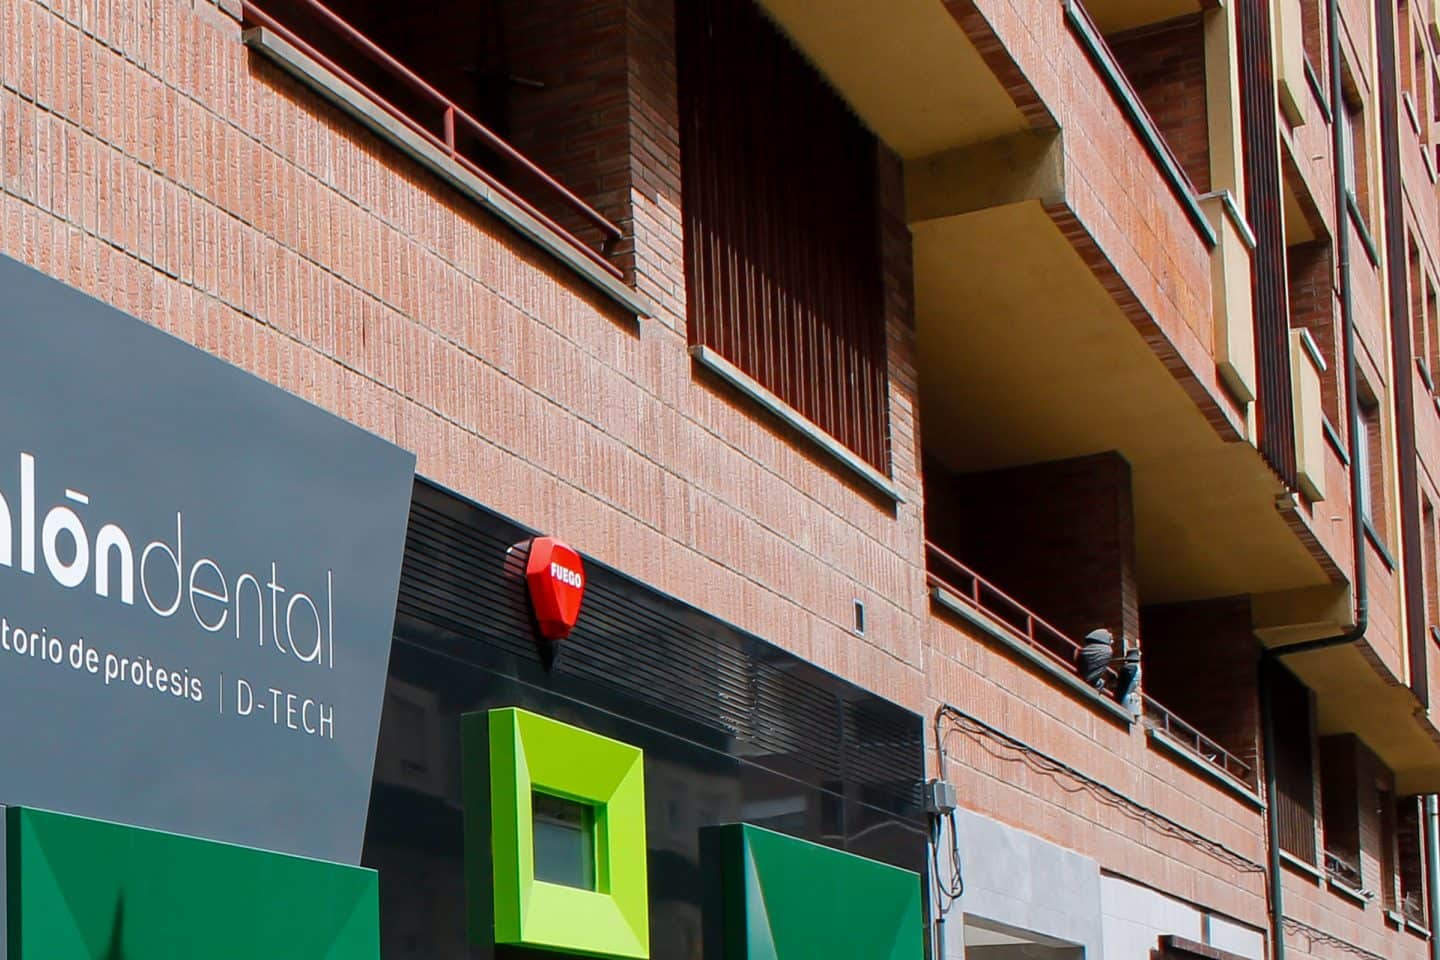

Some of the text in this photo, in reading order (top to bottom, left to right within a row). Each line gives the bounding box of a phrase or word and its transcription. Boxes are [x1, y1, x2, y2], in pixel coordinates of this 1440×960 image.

[550, 561, 582, 589] FUEGO
[69, 638, 99, 673] de
[237, 679, 334, 739] D-TECH
